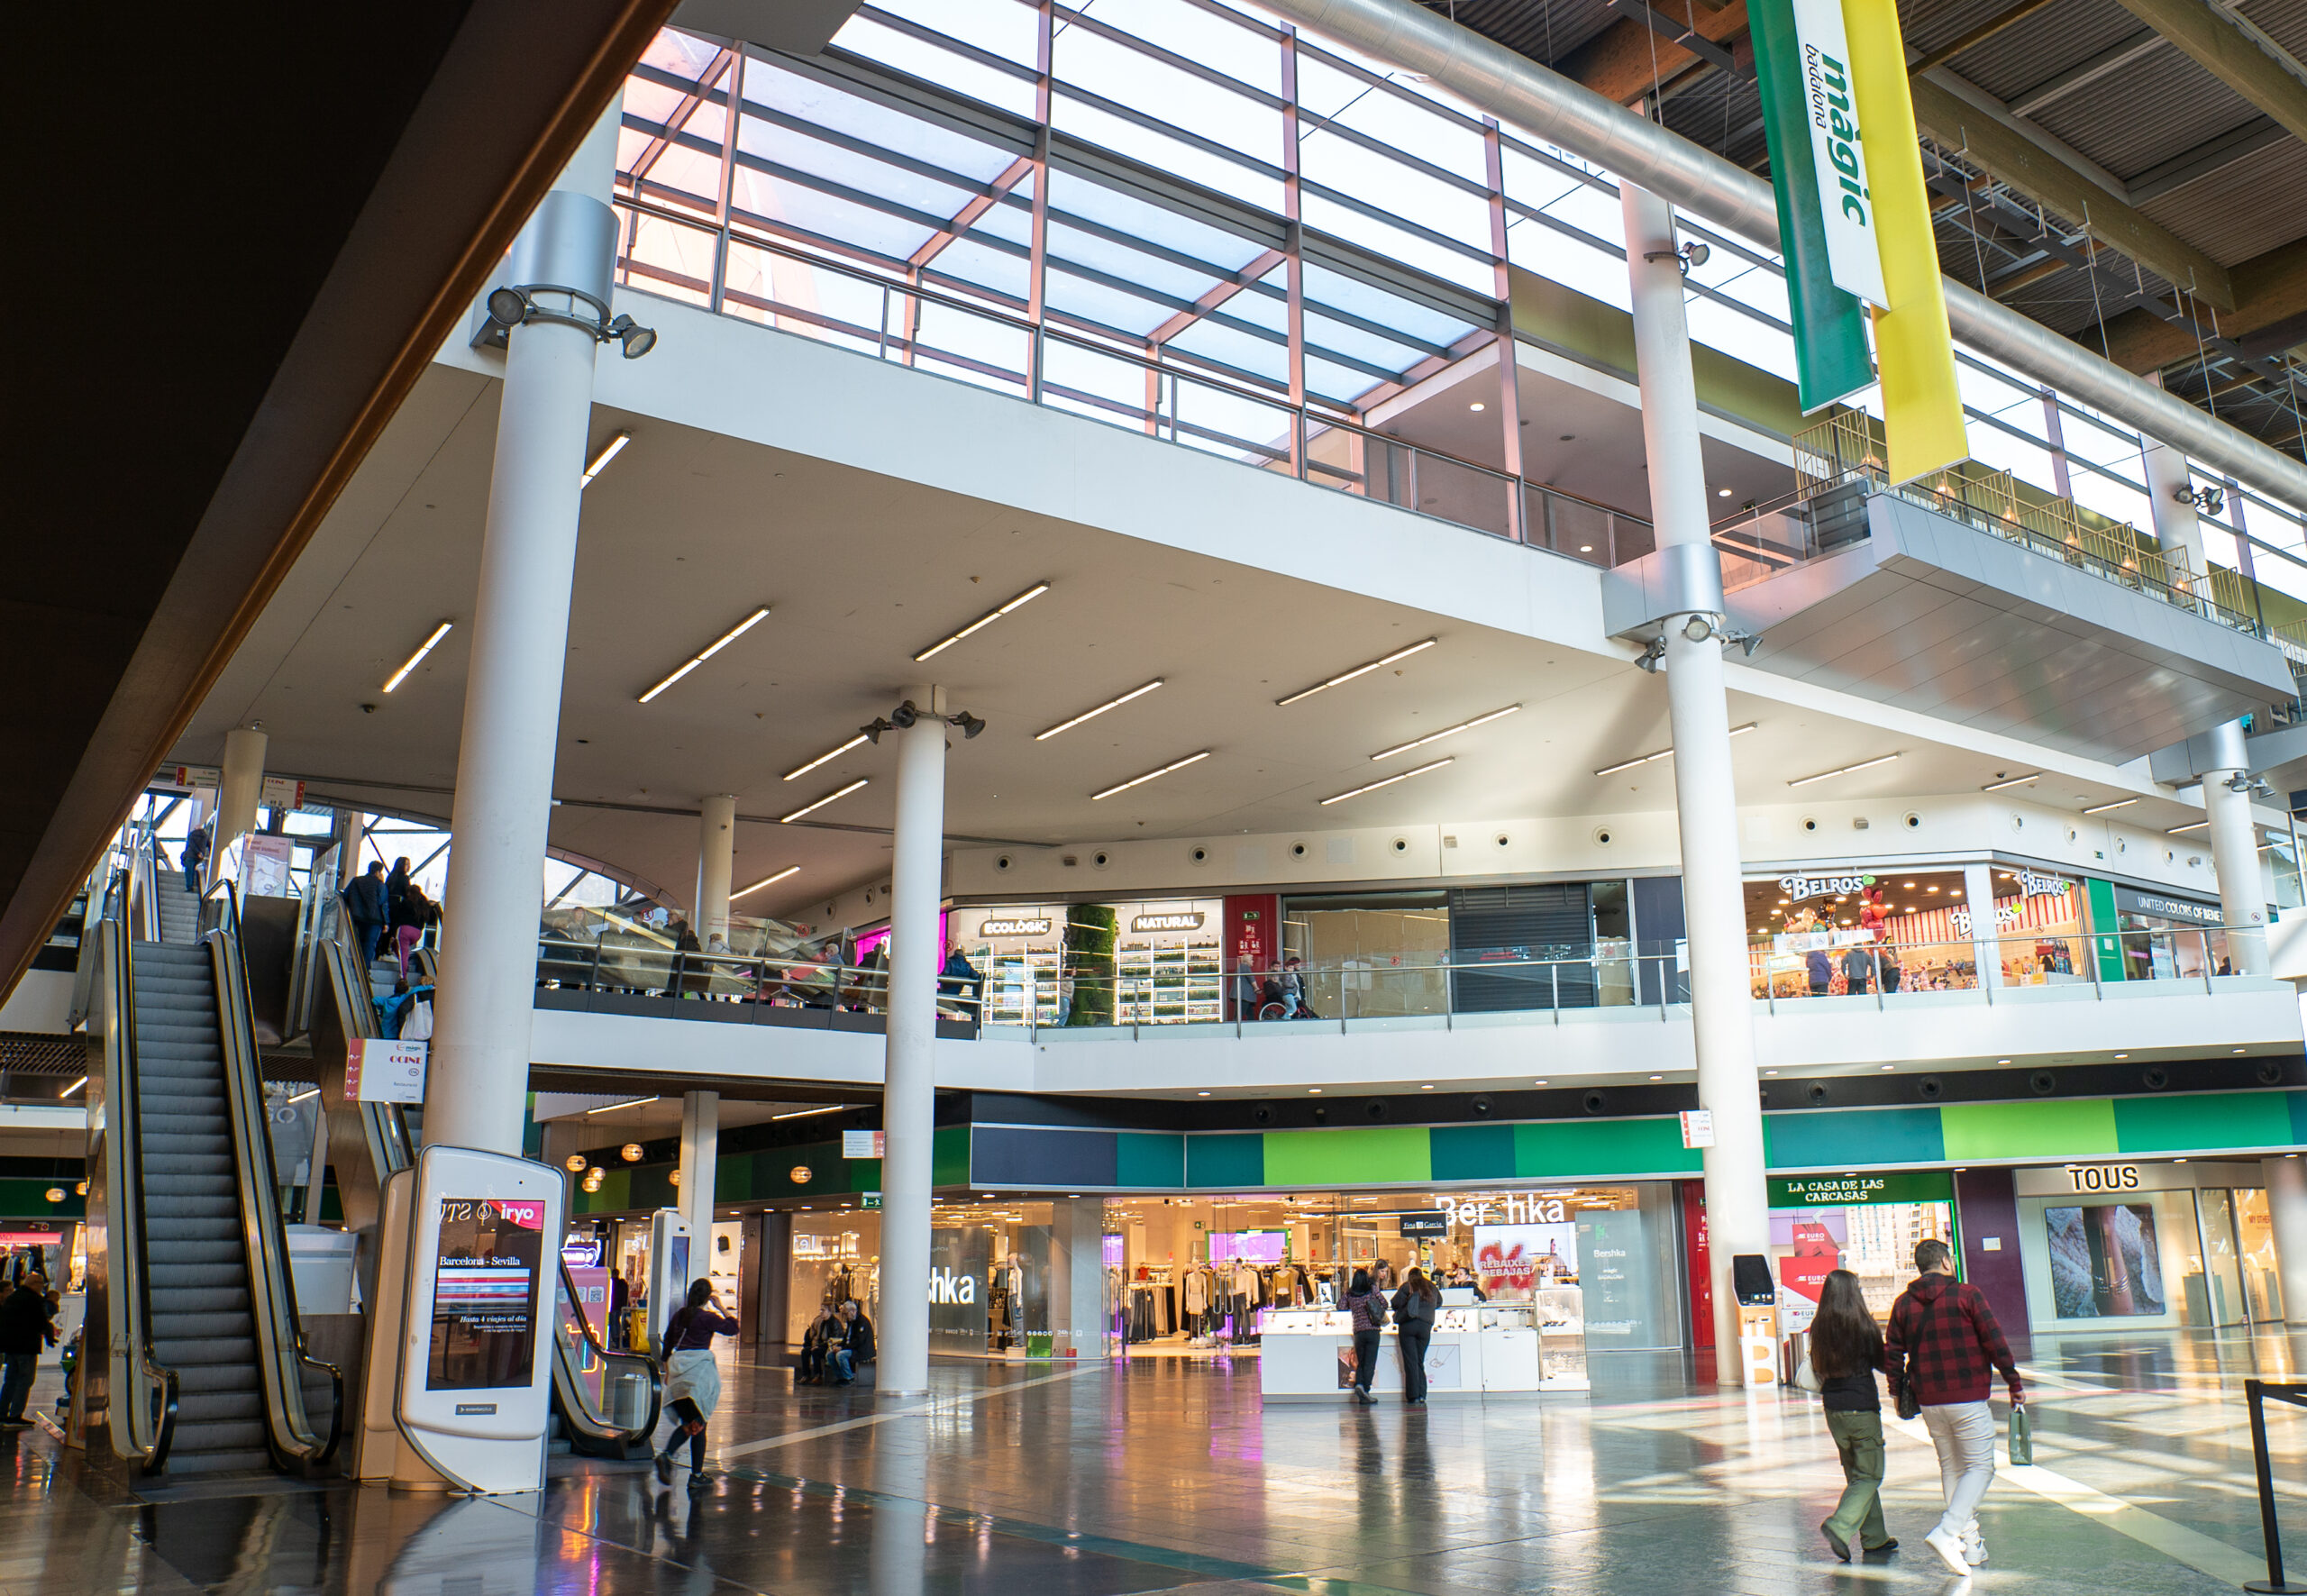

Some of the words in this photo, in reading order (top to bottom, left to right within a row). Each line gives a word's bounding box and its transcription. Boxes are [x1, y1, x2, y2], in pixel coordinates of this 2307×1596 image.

[1805, 43, 1827, 129] badalona
[1780, 876, 1865, 903] BELROS
[2021, 871, 2065, 897] BELROS
[2138, 896, 2165, 912] UNITED
[2165, 901, 2193, 917] COLORS
[2193, 906, 2203, 919] OF
[1137, 916, 1199, 929] NATURAL
[2069, 1166, 2138, 1190] TOUS
[1788, 1182, 1805, 1192] LA
[1809, 1181, 1840, 1191] CASA
[1841, 1181, 1858, 1190] DE
[1861, 1179, 1884, 1190] LAS
[1805, 1190, 1868, 1202] CARCASAS
[500, 1203, 534, 1224] iryo
[1593, 1249, 1626, 1258] Bershka
[439, 1256, 484, 1266] Barcelona
[491, 1256, 521, 1266] Sevilla
[1482, 1267, 1530, 1277] REBAJAS
[487, 1316, 506, 1324] viajes
